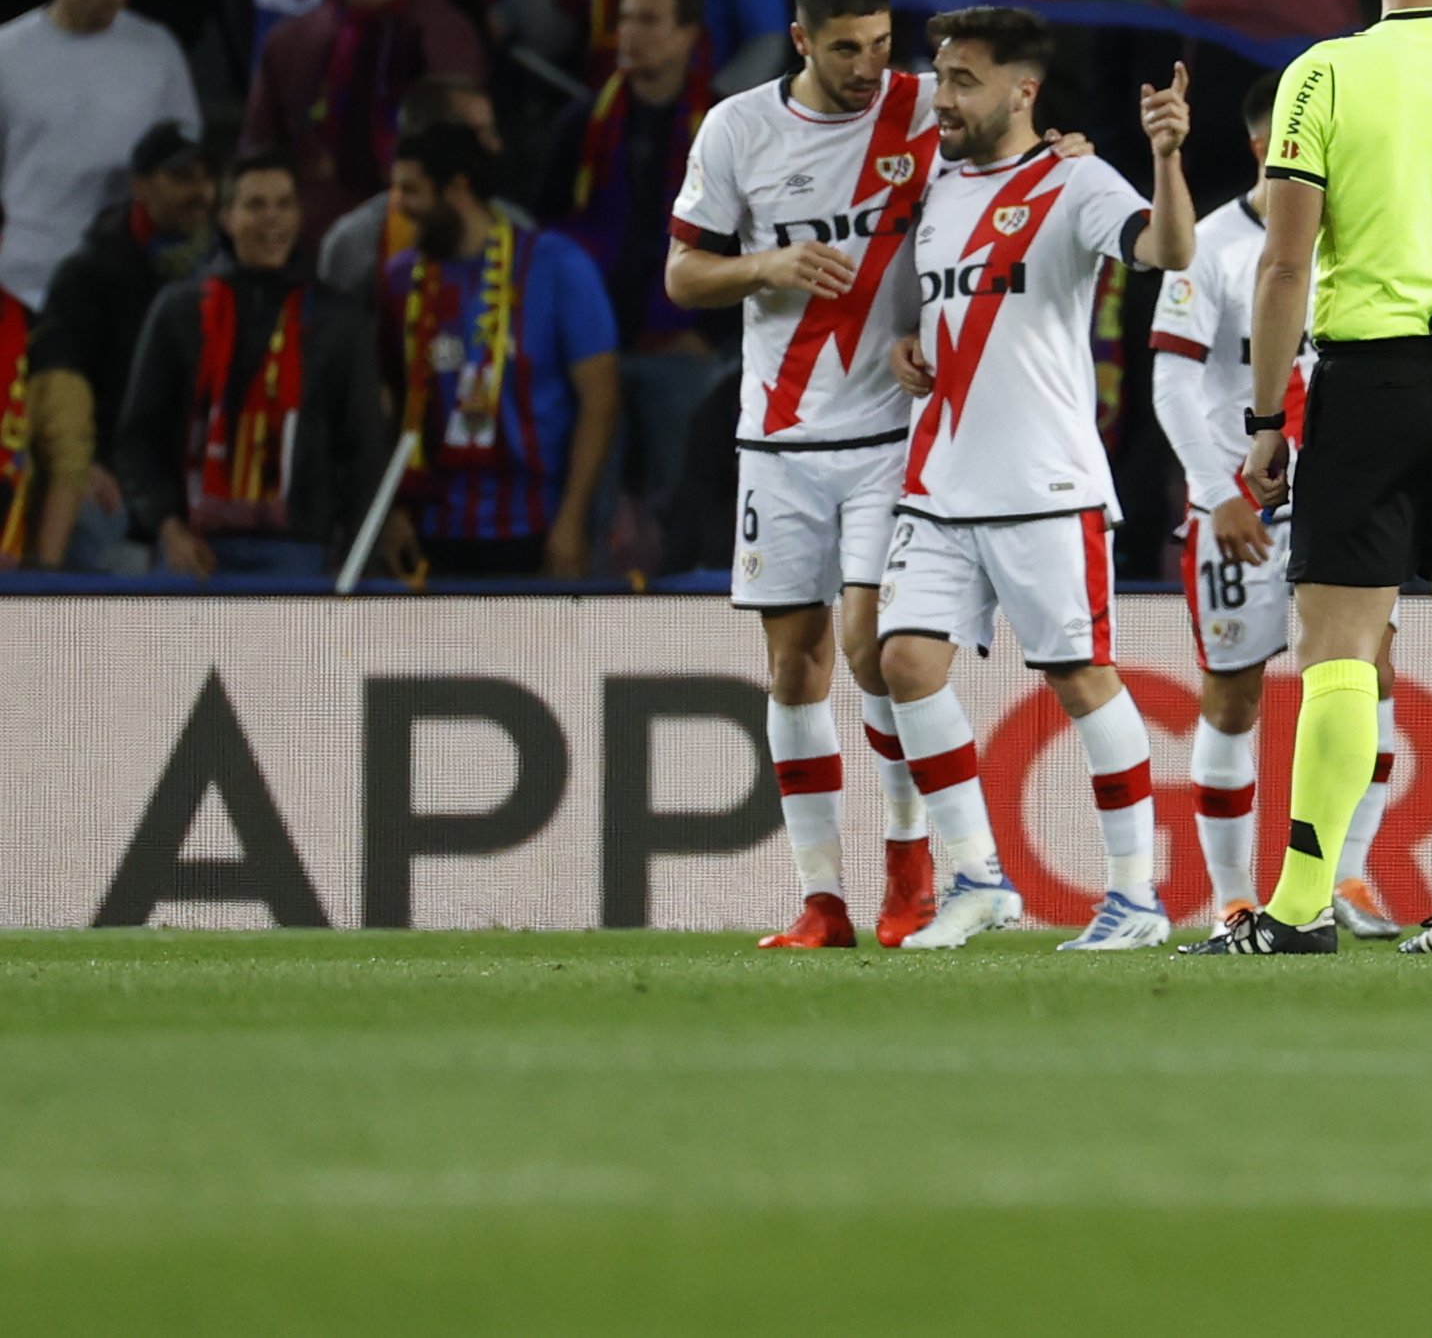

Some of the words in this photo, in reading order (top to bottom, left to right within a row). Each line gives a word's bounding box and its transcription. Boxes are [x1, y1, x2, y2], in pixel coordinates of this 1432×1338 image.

[1286, 70, 1323, 135] WÜRTH
[742, 489, 759, 543] 6
[1200, 560, 1247, 612] 18
[93, 662, 784, 928] APP
